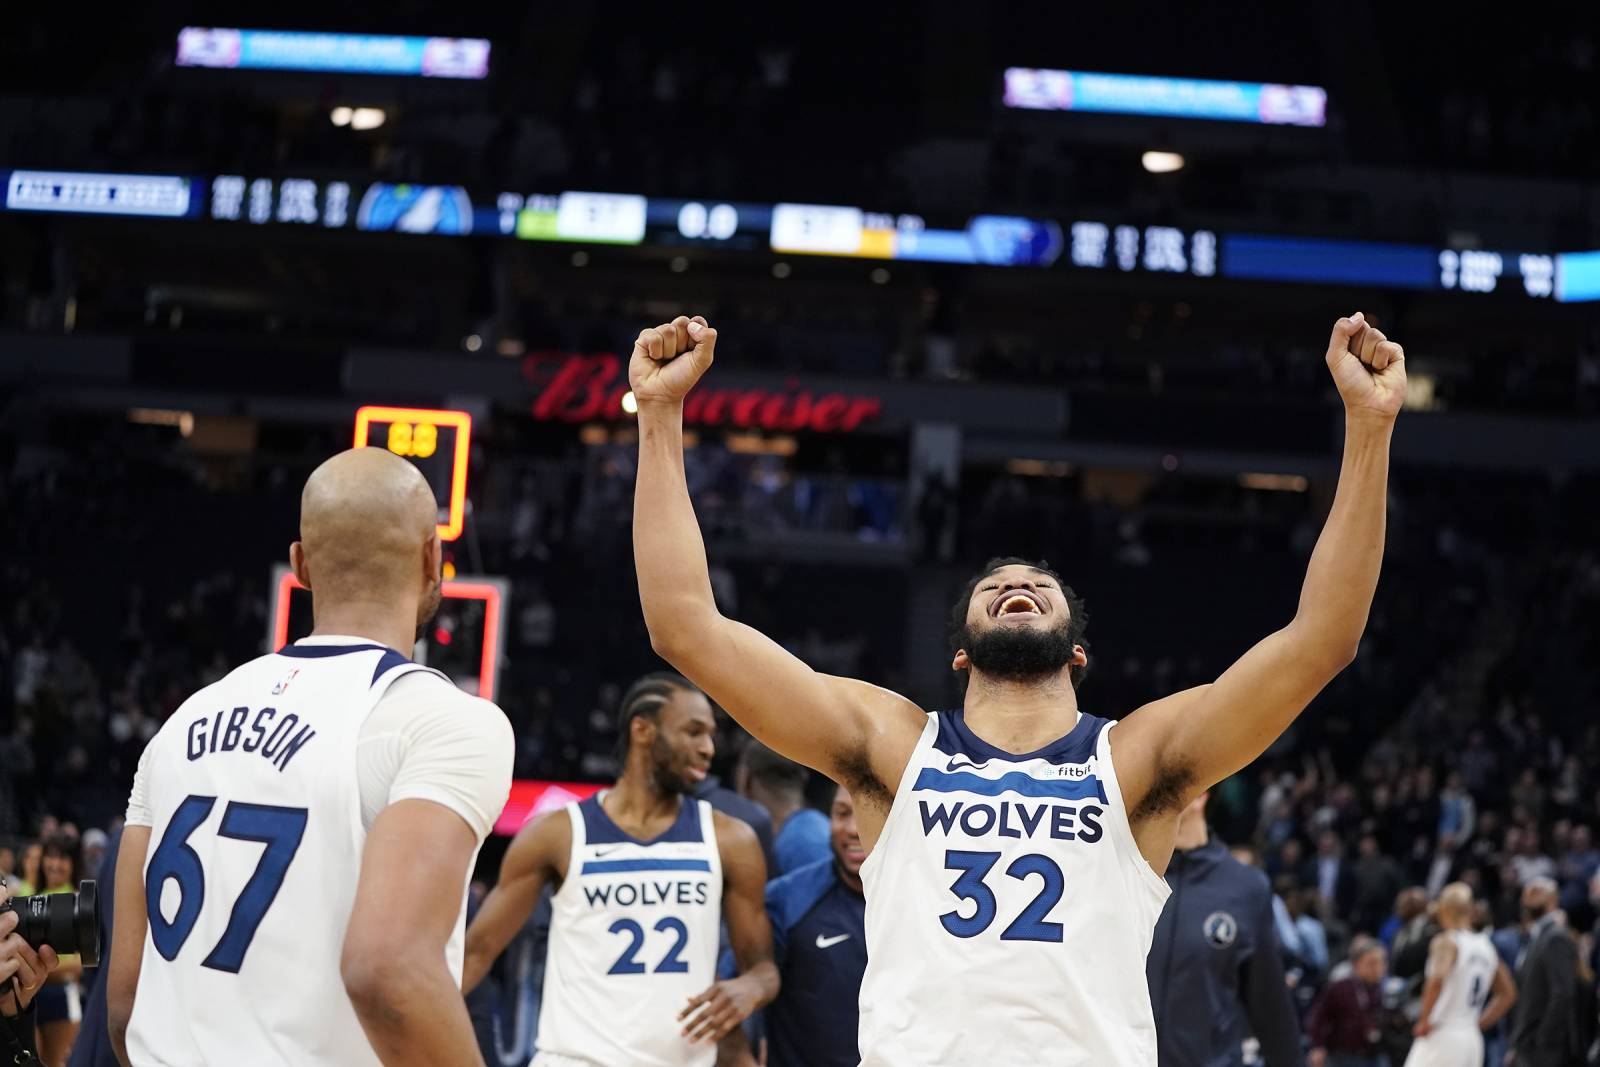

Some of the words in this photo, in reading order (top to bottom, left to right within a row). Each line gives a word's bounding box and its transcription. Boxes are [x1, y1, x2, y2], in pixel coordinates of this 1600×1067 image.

[187, 706, 316, 773] GIBSON
[1058, 764, 1091, 777] fitbit
[918, 800, 1104, 844] WOLVES
[145, 794, 309, 975] 67
[584, 881, 708, 907] WOLVES
[939, 849, 1065, 943] 32
[606, 916, 689, 975] 22
